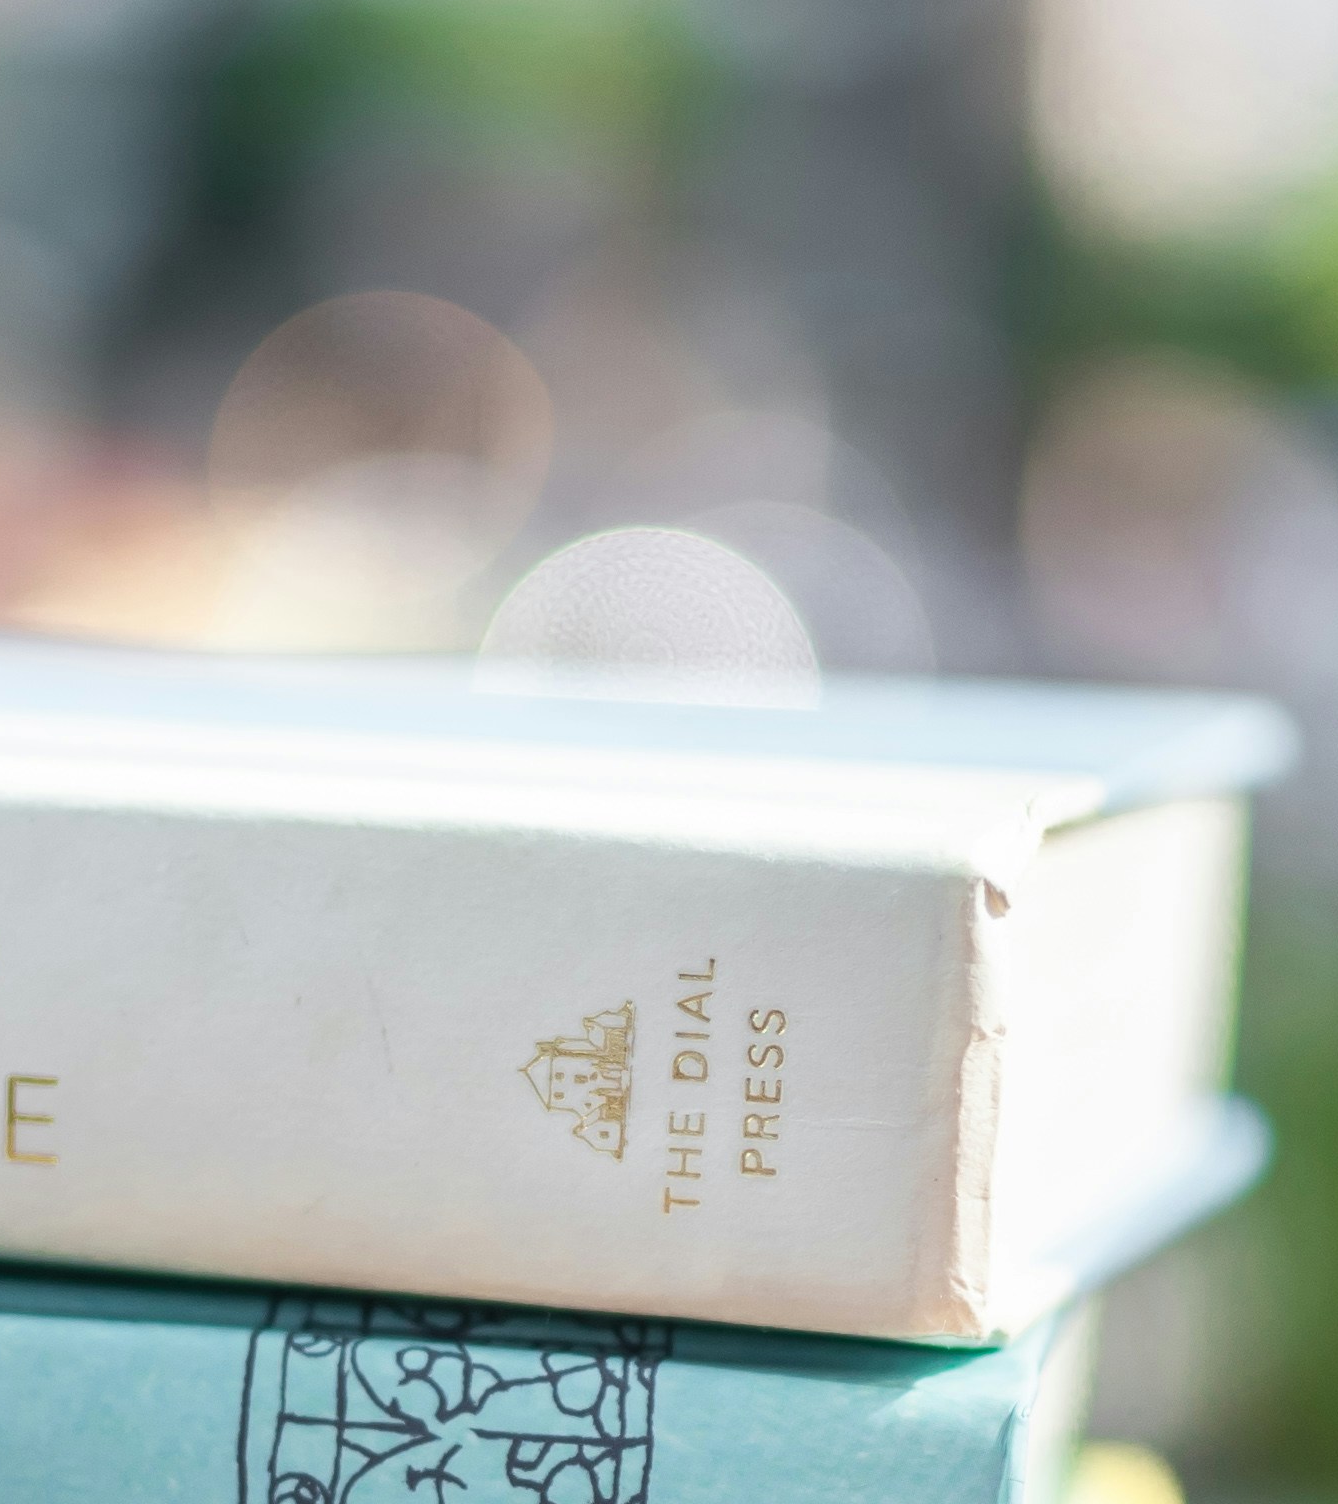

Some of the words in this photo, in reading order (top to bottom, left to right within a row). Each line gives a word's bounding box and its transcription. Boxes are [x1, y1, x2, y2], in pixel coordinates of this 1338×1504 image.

[671, 956, 717, 1084] DIAL
[739, 1008, 789, 1178] PRESS
[663, 1110, 707, 1216] THE
